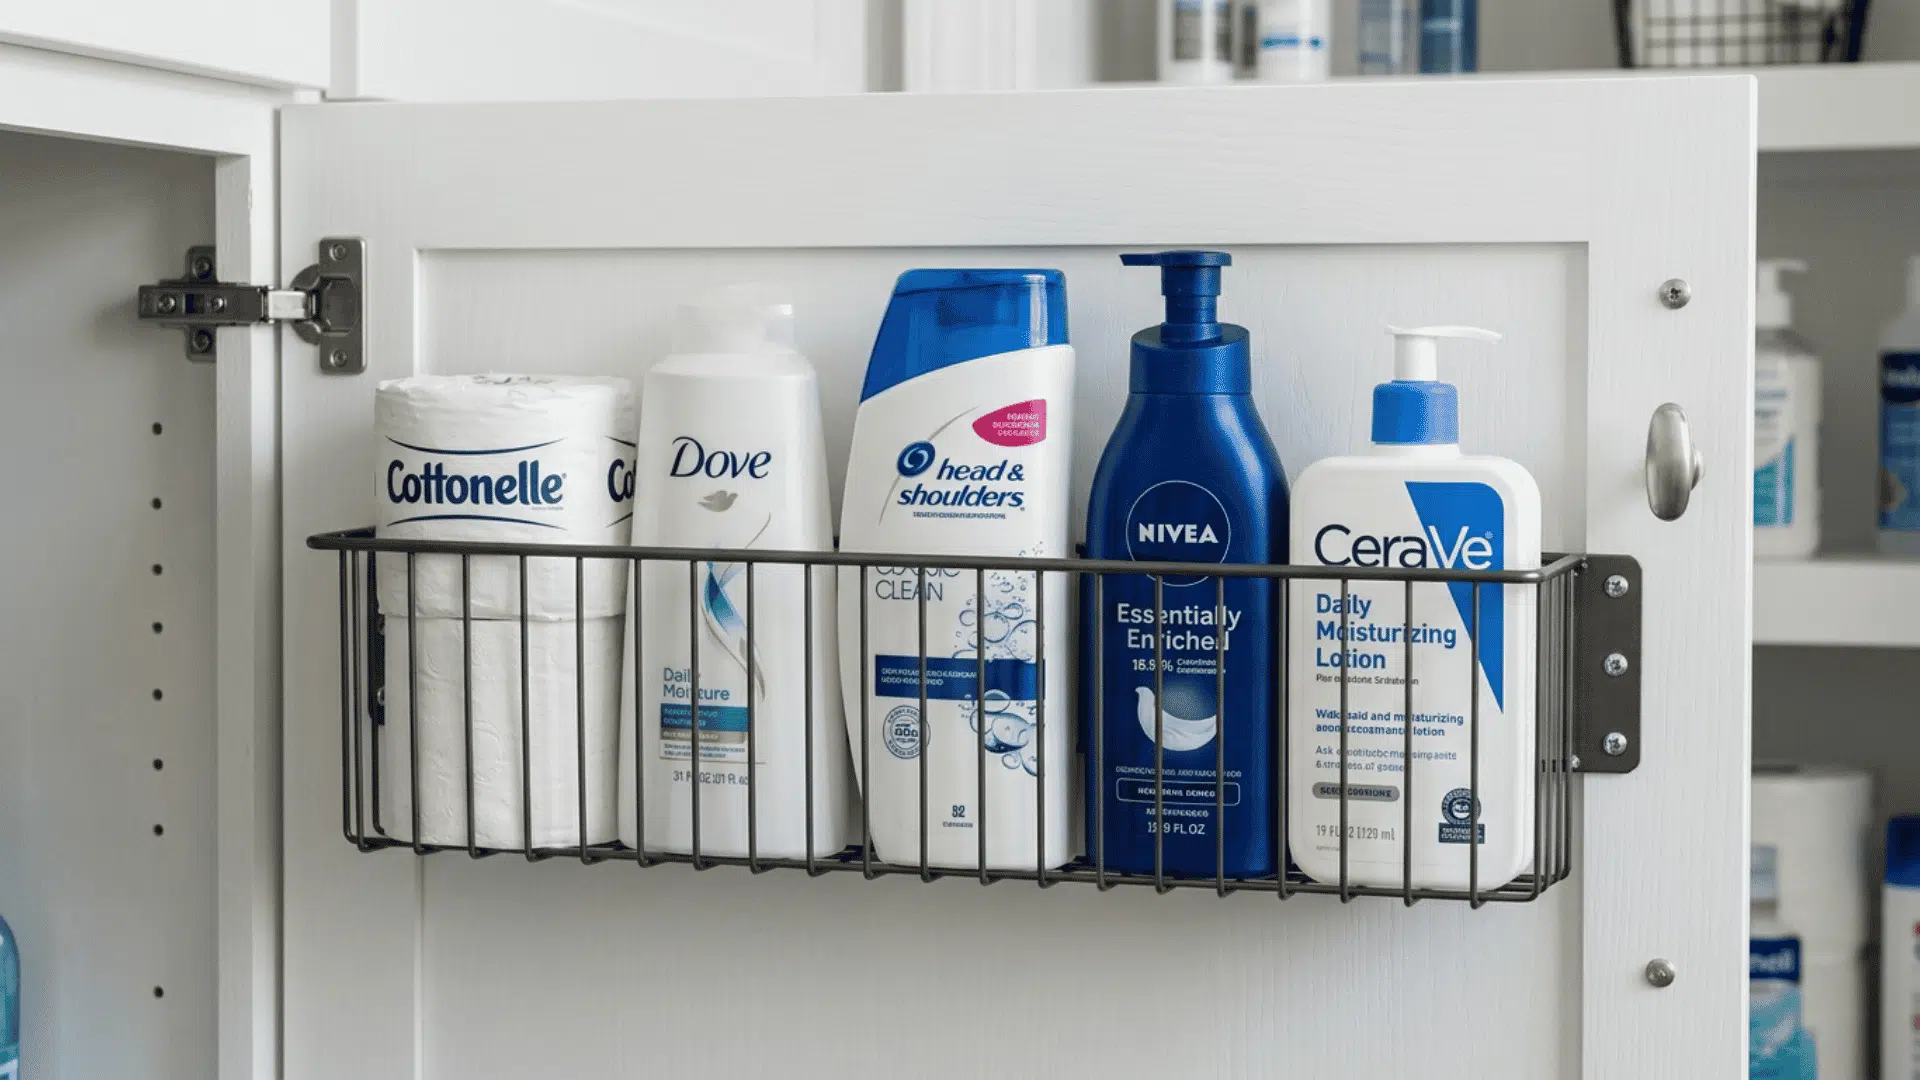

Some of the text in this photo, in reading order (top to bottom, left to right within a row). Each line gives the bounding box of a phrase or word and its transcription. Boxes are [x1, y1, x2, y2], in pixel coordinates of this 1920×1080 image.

[669, 436, 772, 479] Dove
[936, 457, 1025, 481] head &
[387, 459, 564, 505] Cottonelle
[898, 483, 1024, 509] shoulders
[1138, 523, 1219, 544] NIVEA
[1314, 523, 1493, 570] CeraVe
[1316, 593, 1372, 619] Daily
[1316, 648, 1386, 669] Lotion
[663, 667, 701, 683] Dail
[1173, 823, 1187, 834] FL
[1188, 823, 1206, 835] OZ
[1316, 824, 1327, 837] 19
